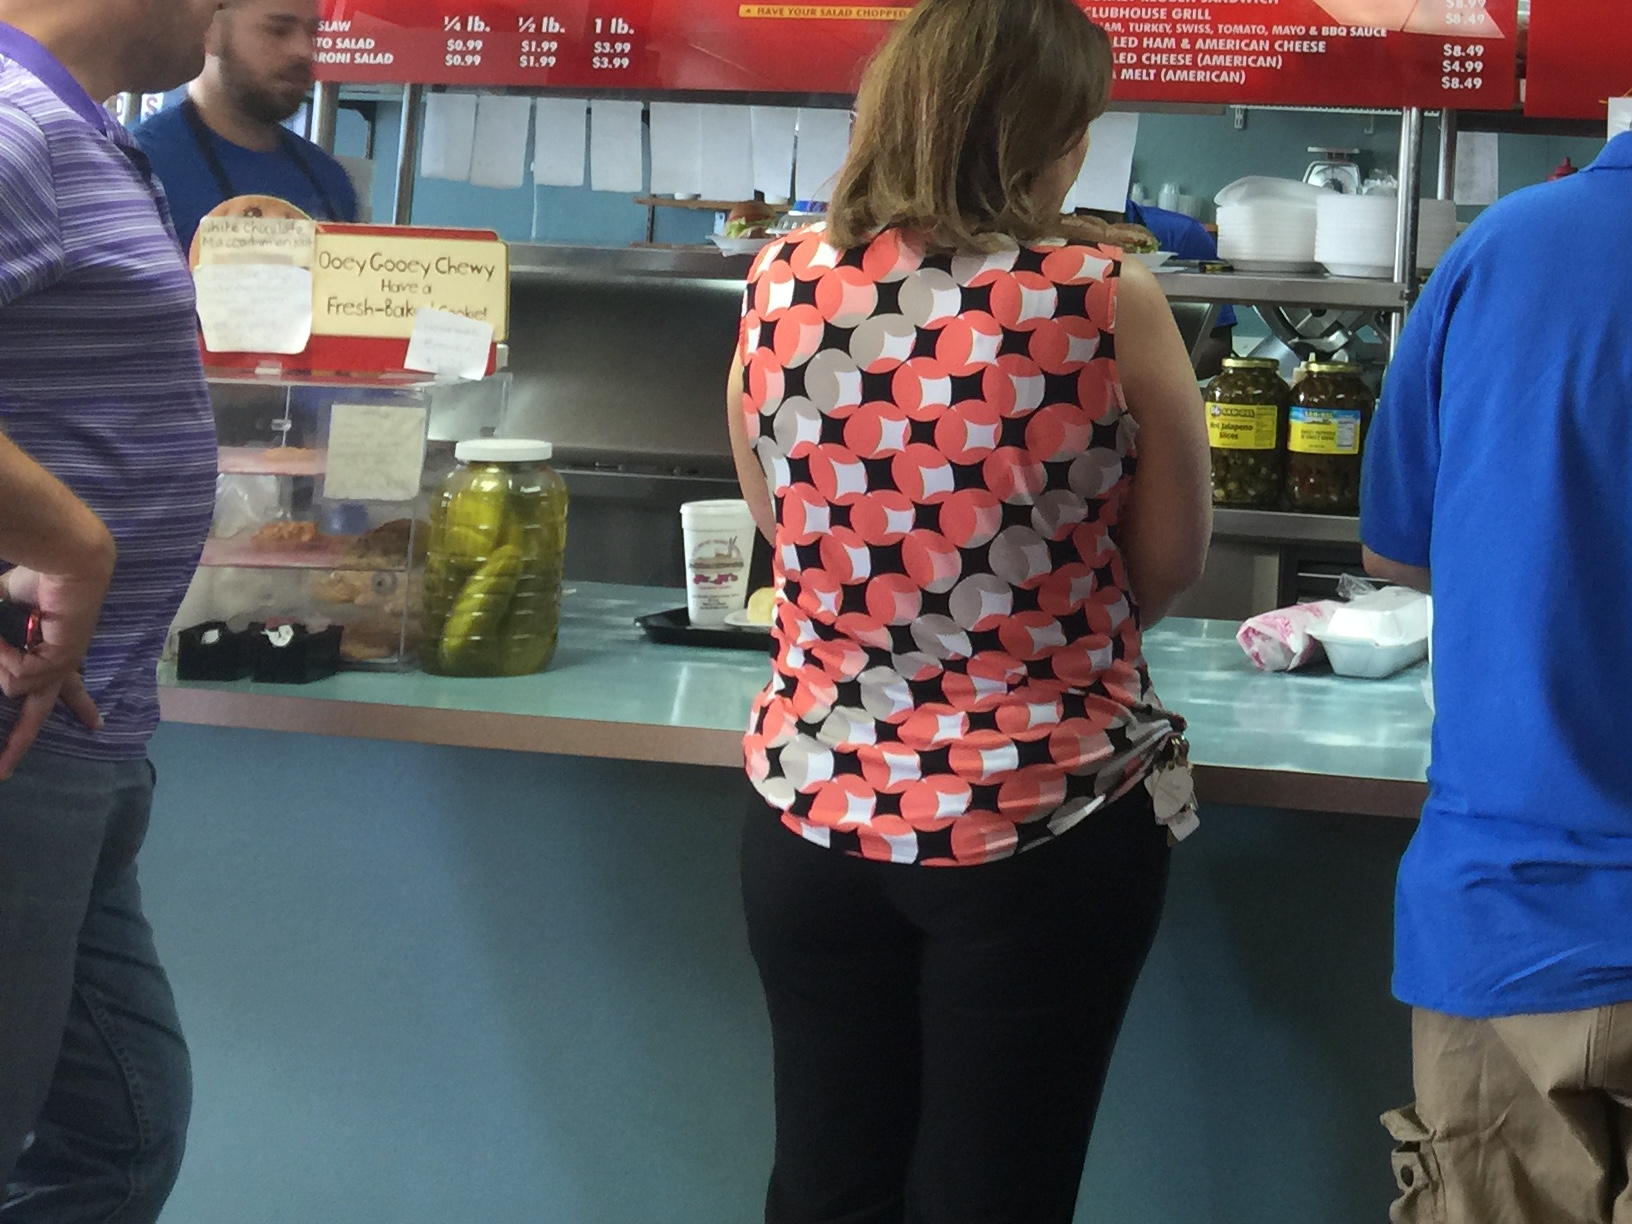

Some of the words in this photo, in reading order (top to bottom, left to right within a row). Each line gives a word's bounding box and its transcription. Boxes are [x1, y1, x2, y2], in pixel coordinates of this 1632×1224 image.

[319, 250, 366, 276] Ooey
[370, 252, 431, 279] Gooey
[435, 256, 496, 282] Chewy
[381, 278, 419, 294] Have
[422, 284, 432, 294] a
